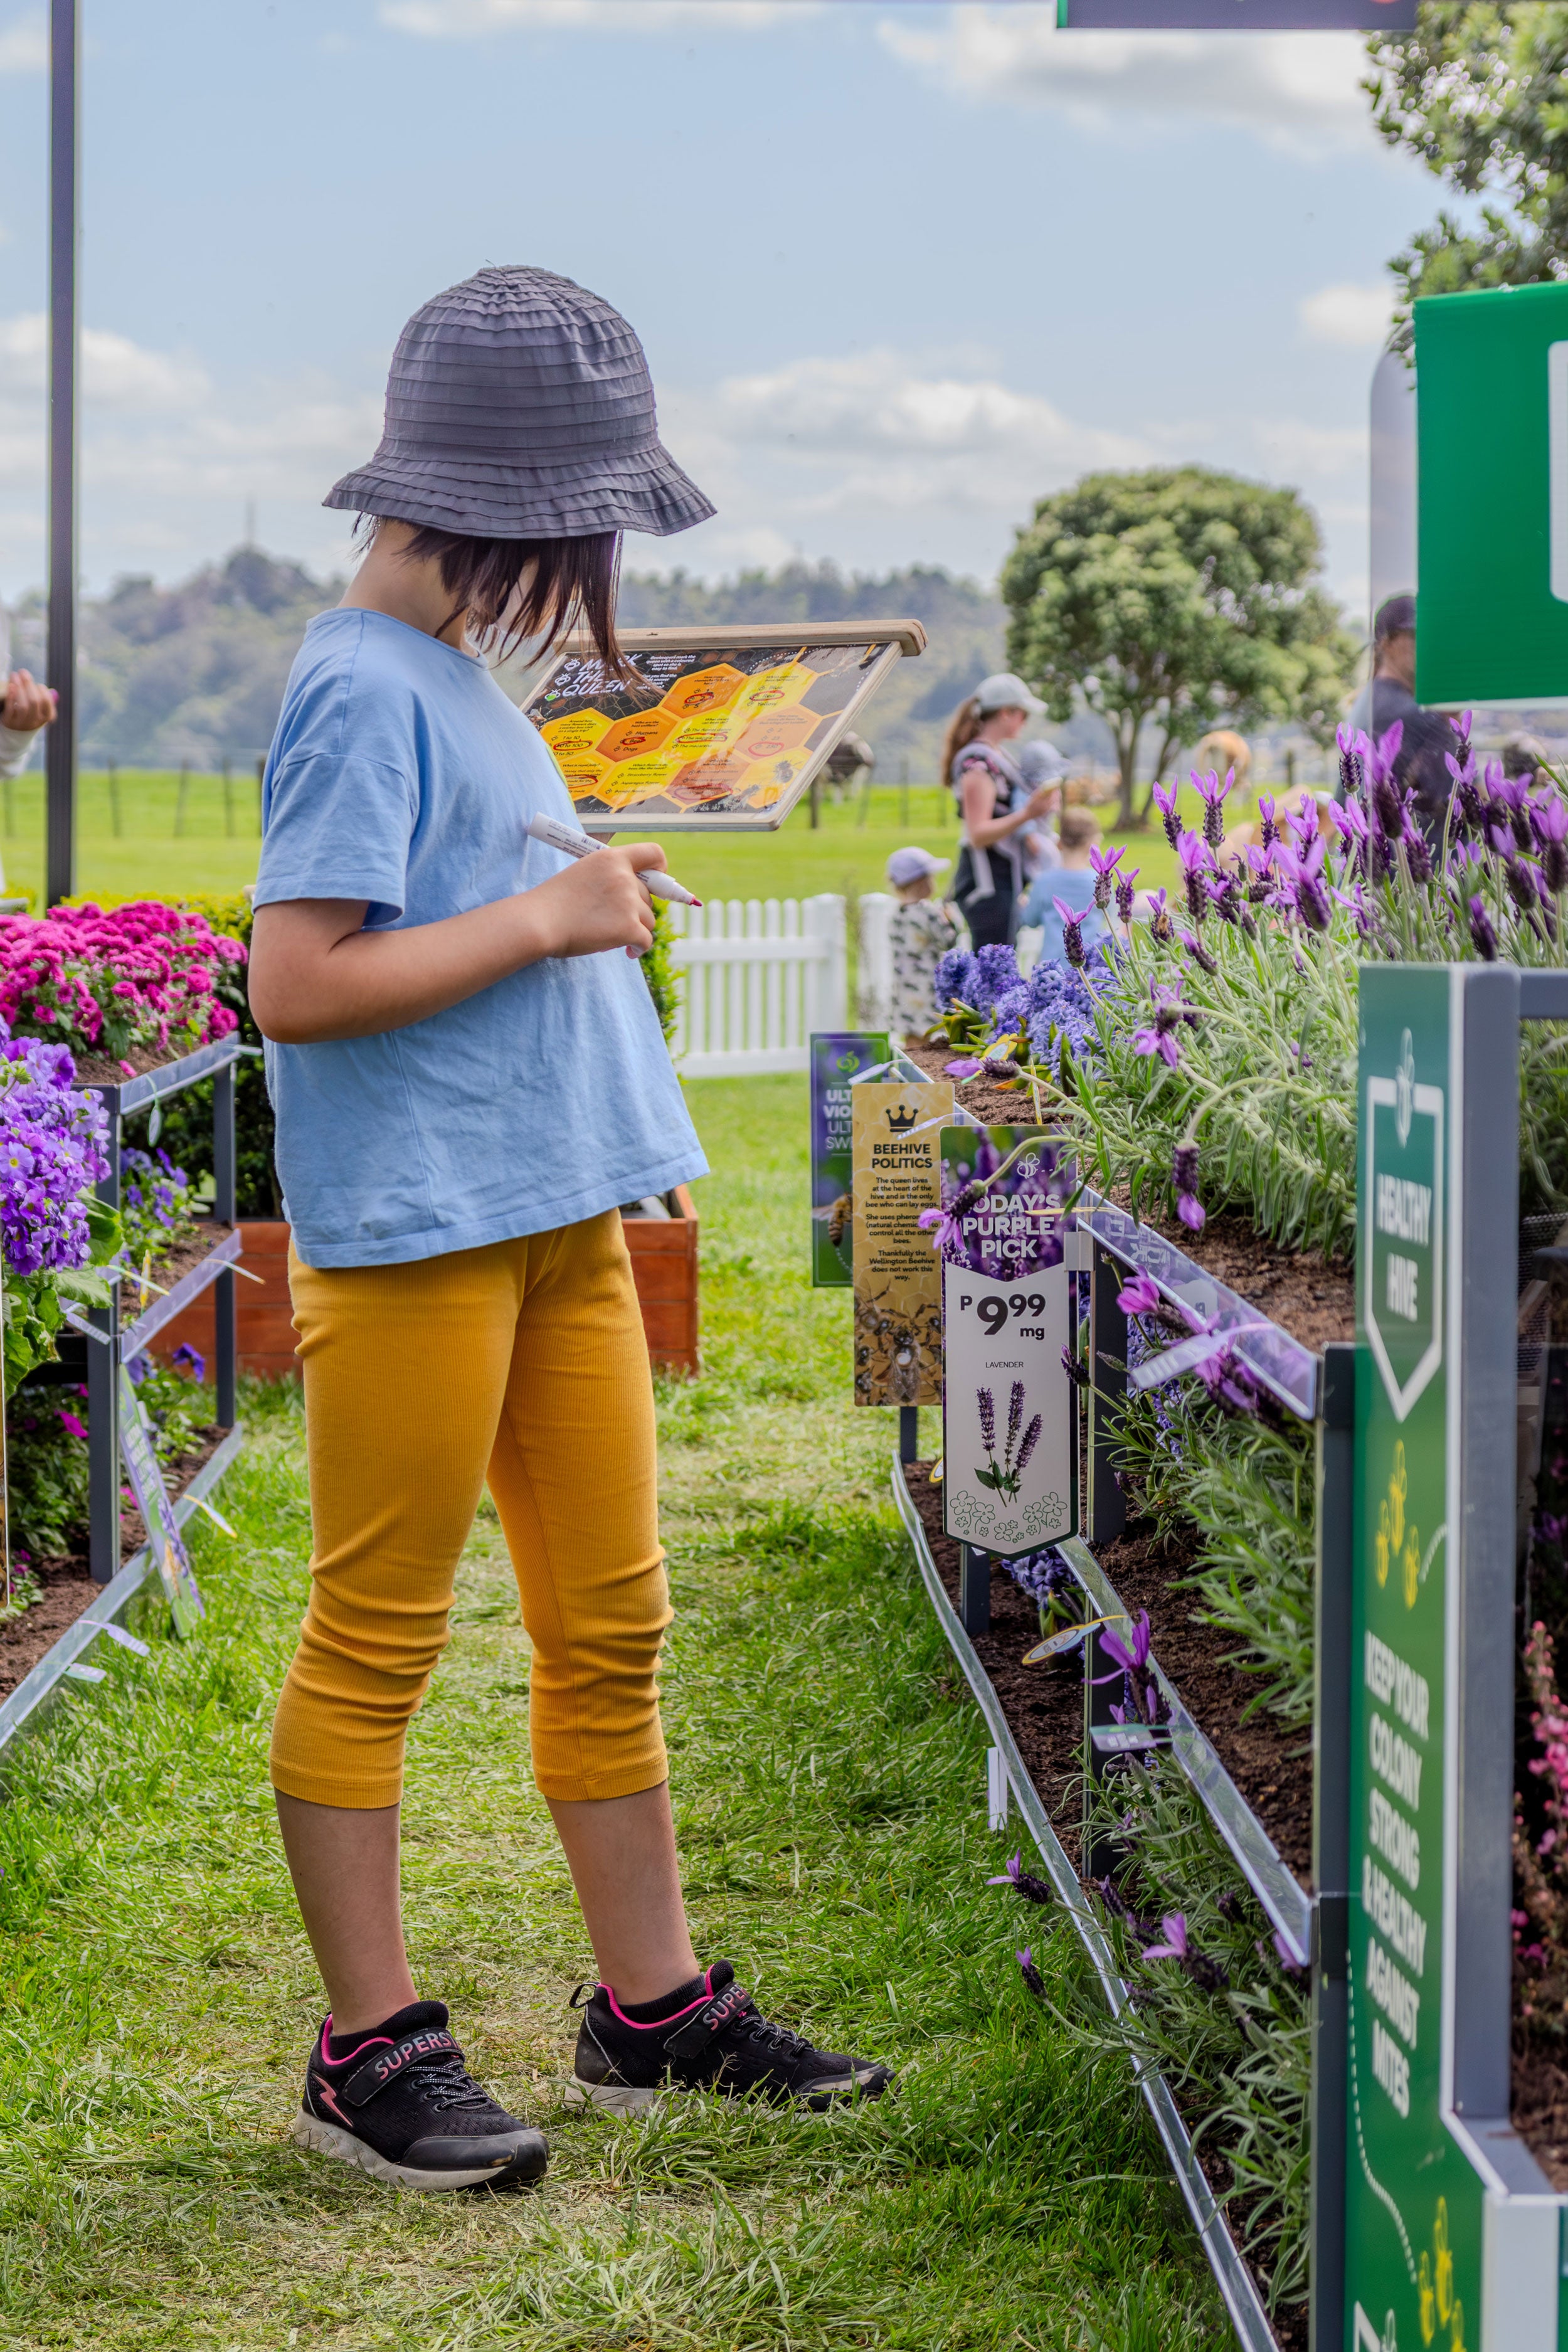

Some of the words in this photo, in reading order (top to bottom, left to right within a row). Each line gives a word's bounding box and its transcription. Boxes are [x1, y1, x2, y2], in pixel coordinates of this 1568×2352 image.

[562, 678, 633, 697] QUEEN
[874, 1143, 931, 1155] BEEHIVE
[872, 1157, 933, 1168] POLITICS
[972, 1194, 1061, 1213] ODAY'S
[1376, 1173, 1433, 1246] HEALTHY
[963, 1216, 1055, 1236] PURPLE
[981, 1239, 1037, 1258] PICK
[869, 1258, 907, 1266] Wellington
[1387, 1253, 1418, 1323] HIVE
[960, 1295, 973, 1311] P
[1020, 1327, 1045, 1340] mg
[1364, 1629, 1394, 1706] KEEP
[1392, 1654, 1429, 1742] YOUR
[1369, 1712, 1422, 1813] COLONY
[1369, 1787, 1420, 1891] STRONG
[1366, 1936, 1420, 2050] AGAINST
[1372, 2018, 1409, 2119] MITES
